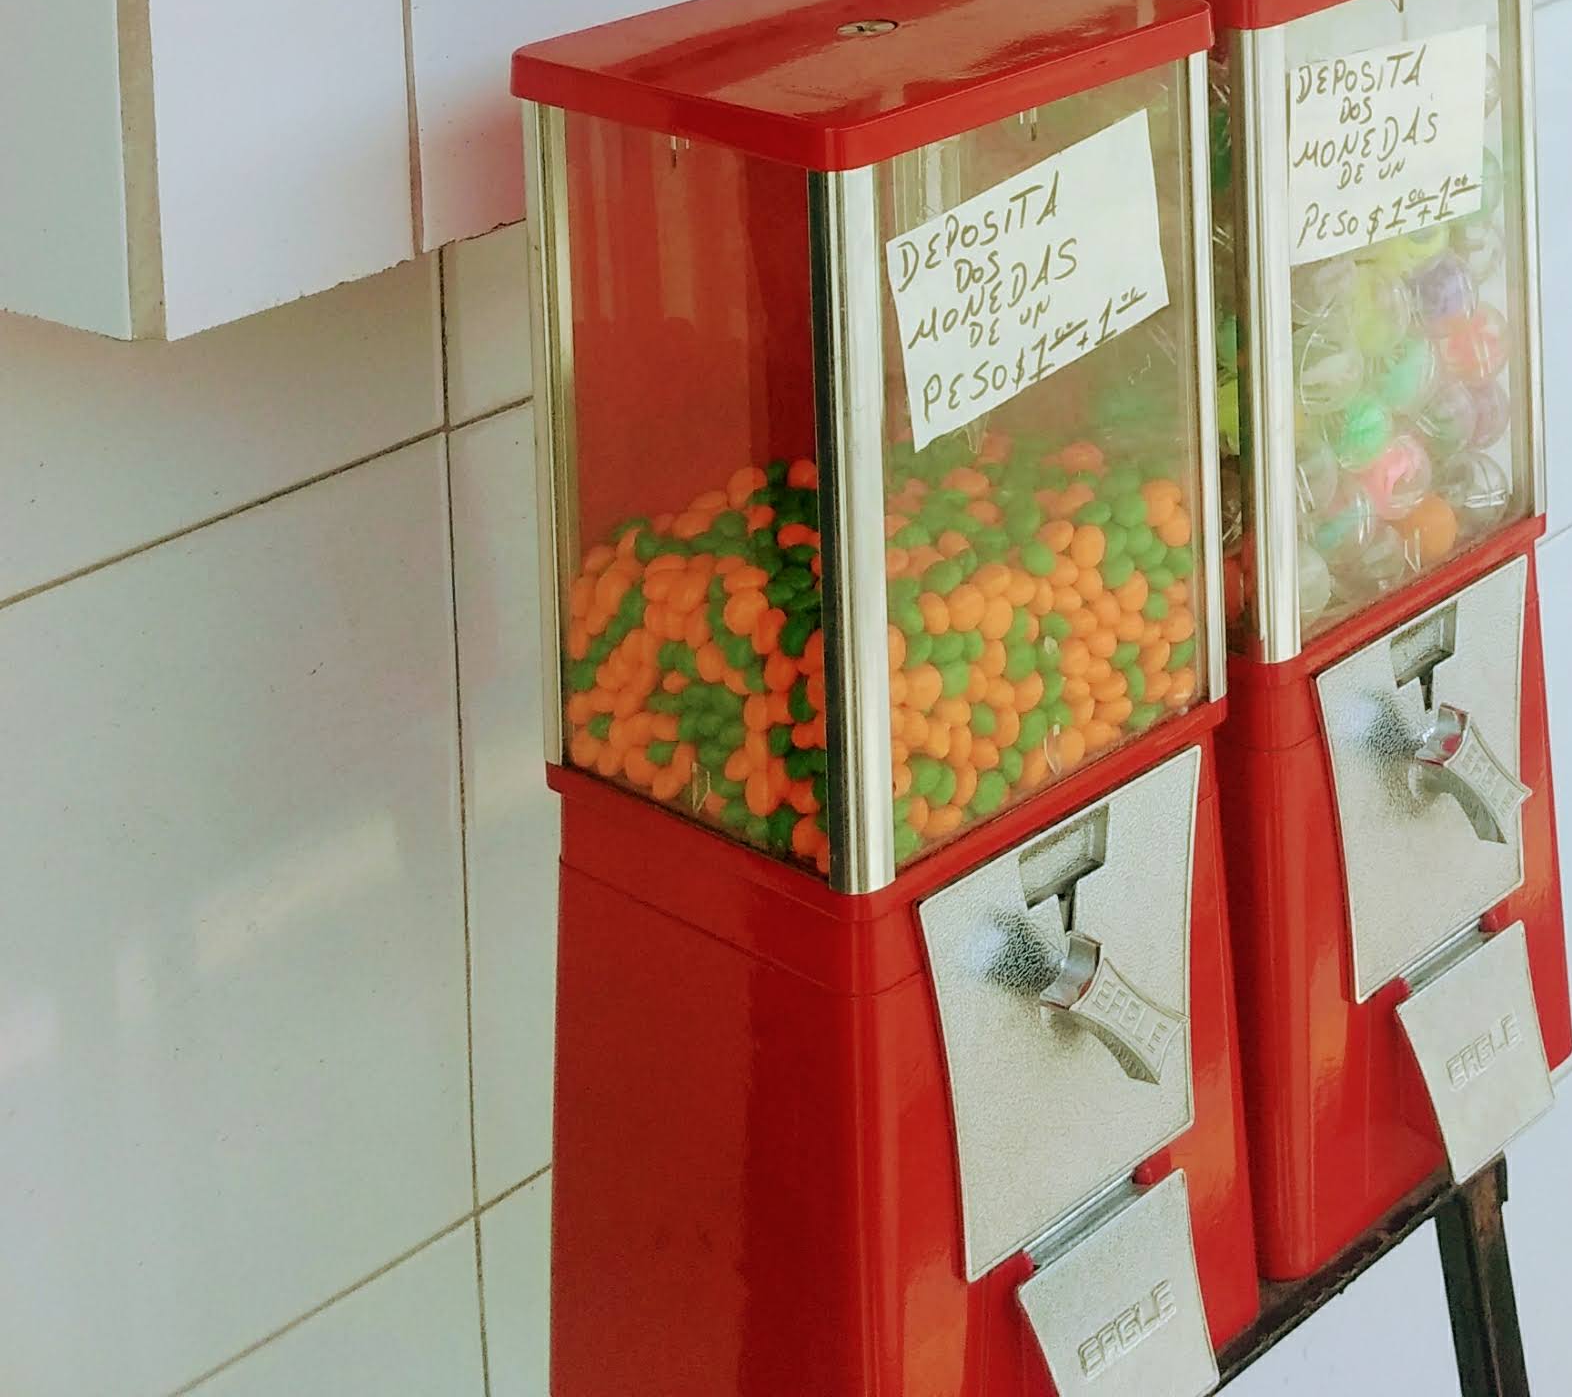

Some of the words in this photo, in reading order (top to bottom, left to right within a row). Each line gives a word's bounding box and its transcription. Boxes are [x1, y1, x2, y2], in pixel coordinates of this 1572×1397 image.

[1296, 43, 1428, 105] DEPOSITA
[1293, 106, 1439, 167] MONEDAS
[1339, 96, 1373, 125] DOS
[1337, 160, 1364, 190] DE
[1378, 157, 1406, 180] UN
[896, 169, 1060, 293] DEPOSITA
[1297, 202, 1359, 249] PESO
[907, 238, 1079, 350] MONEDAS
[954, 250, 1001, 293] DOS
[969, 320, 1001, 349] DE
[1019, 294, 1052, 328] UN
[922, 360, 1008, 424] PESO
[1092, 979, 1169, 1055] EAGLE
[1445, 1011, 1521, 1091] EAGLE
[1077, 1278, 1177, 1382] EAGLE
